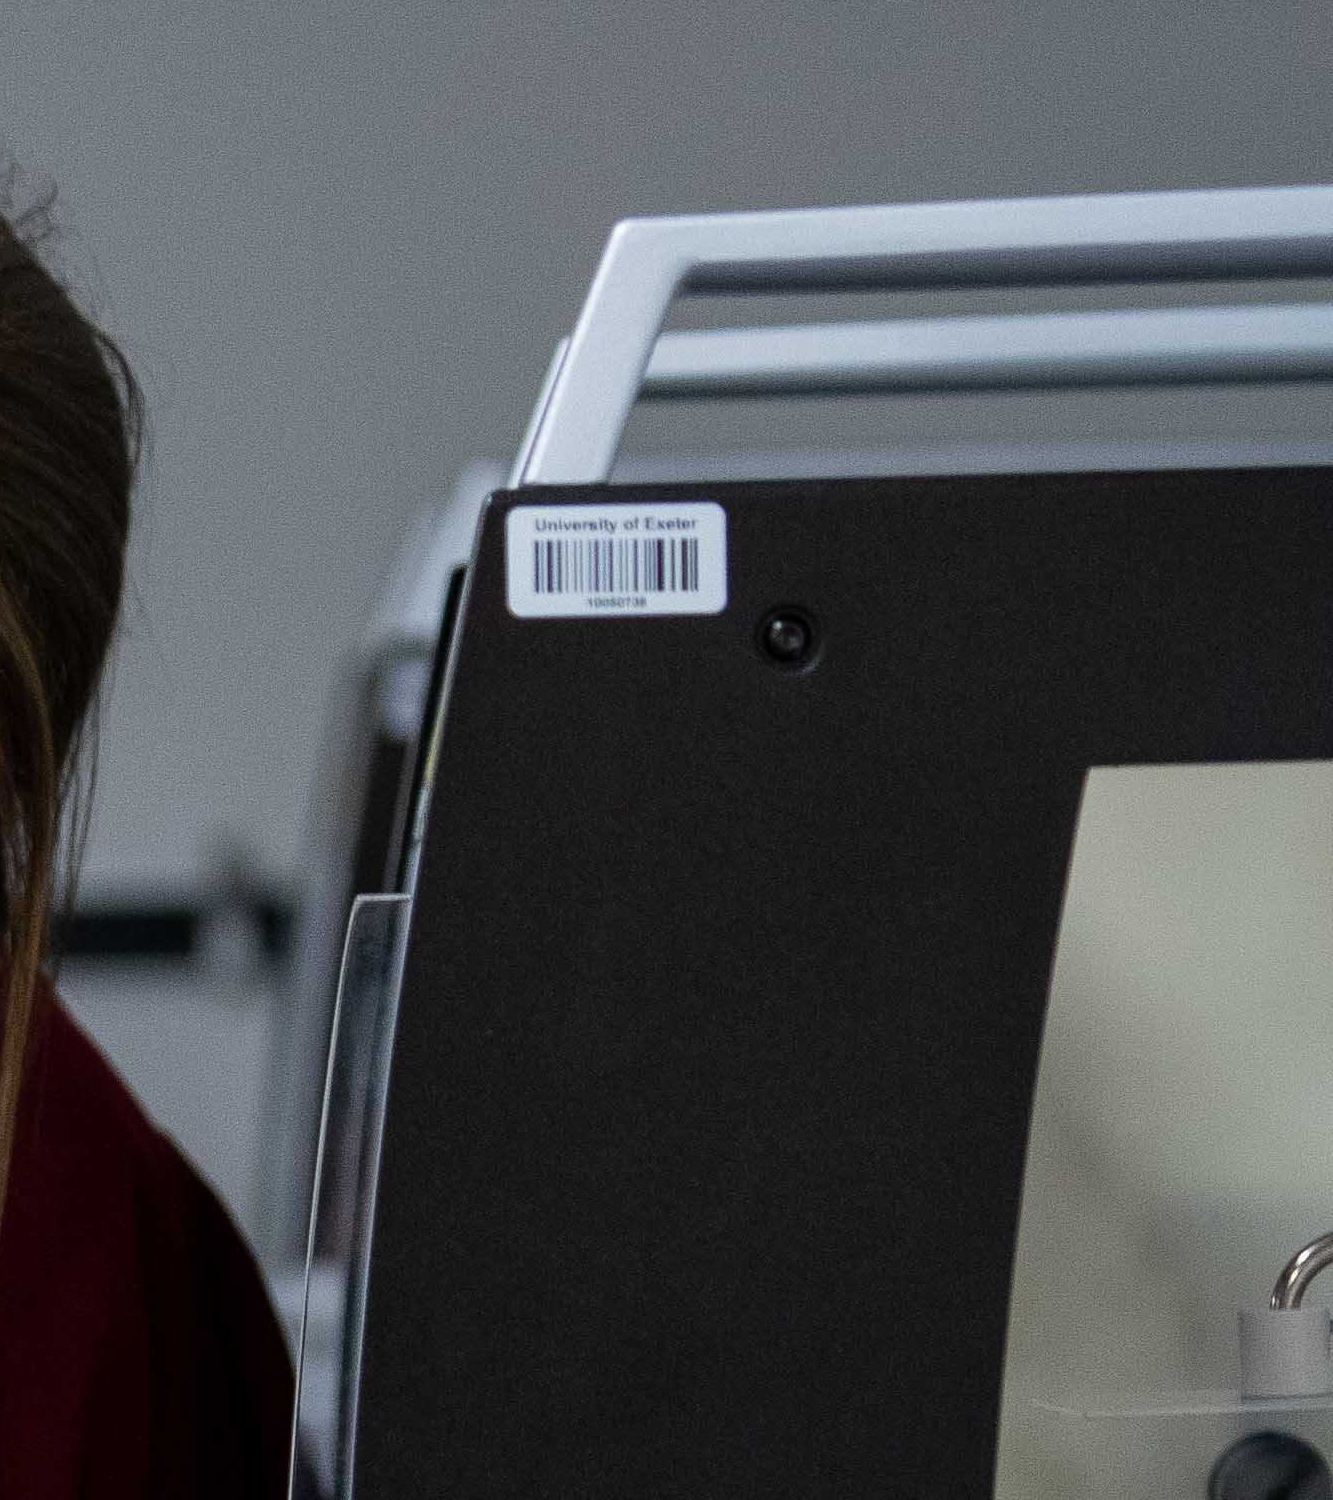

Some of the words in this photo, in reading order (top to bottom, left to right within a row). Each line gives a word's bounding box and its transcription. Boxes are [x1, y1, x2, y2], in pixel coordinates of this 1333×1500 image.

[534, 517, 618, 533] University
[623, 517, 639, 531] of
[644, 516, 697, 531] Exeter
